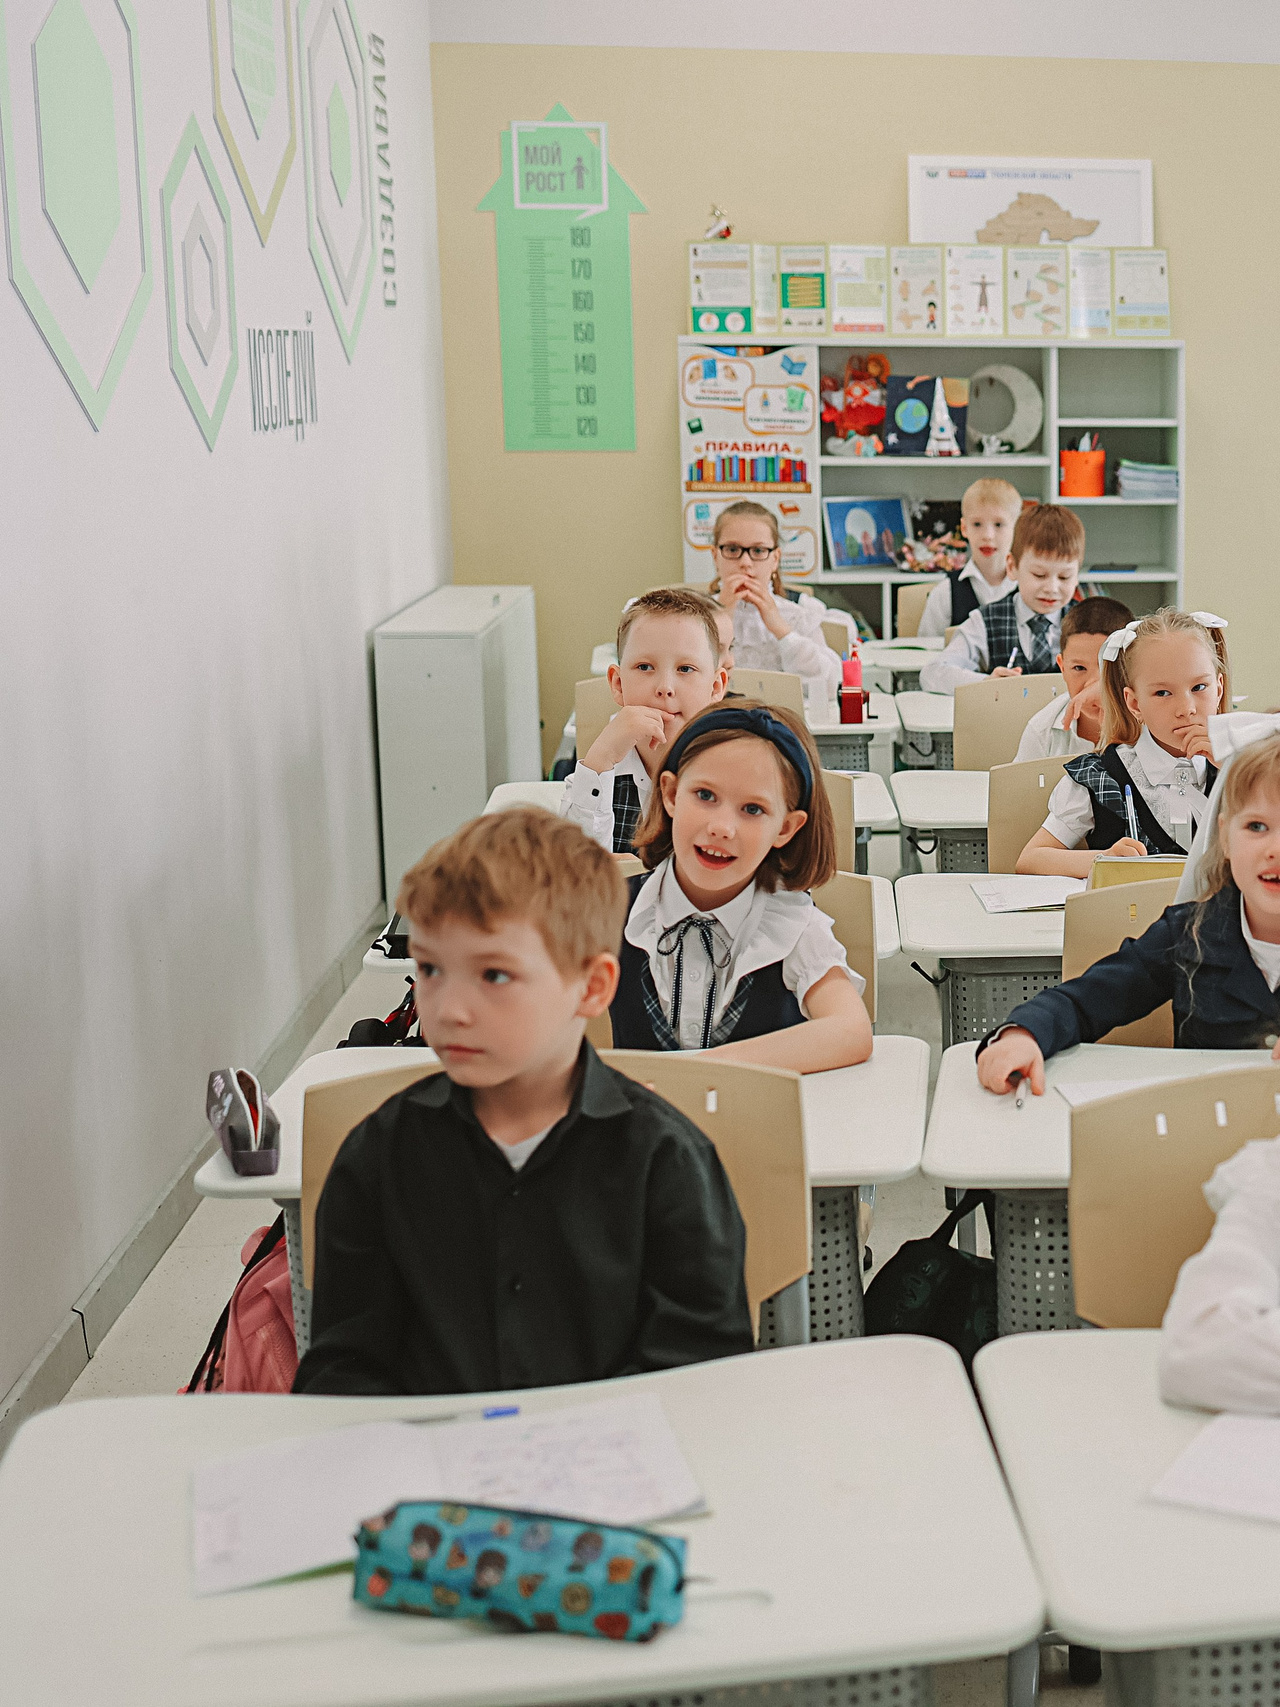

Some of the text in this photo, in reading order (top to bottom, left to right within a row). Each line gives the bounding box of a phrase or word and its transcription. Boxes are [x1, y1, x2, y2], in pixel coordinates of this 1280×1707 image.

[524, 140, 562, 166] МОЙ
[368, 32, 397, 307] СОЗДАВАЙ
[525, 171, 566, 192] РОСТ
[570, 226, 591, 248] 180
[571, 257, 592, 280] 170
[572, 289, 594, 312] 160
[573, 321, 595, 344] 150
[574, 353, 597, 375] 140
[247, 311, 318, 441] ИССЛЕДУЙ
[575, 385, 597, 406] 130
[576, 416, 599, 438] 120
[705, 441, 792, 453] ПРАВИЛА
